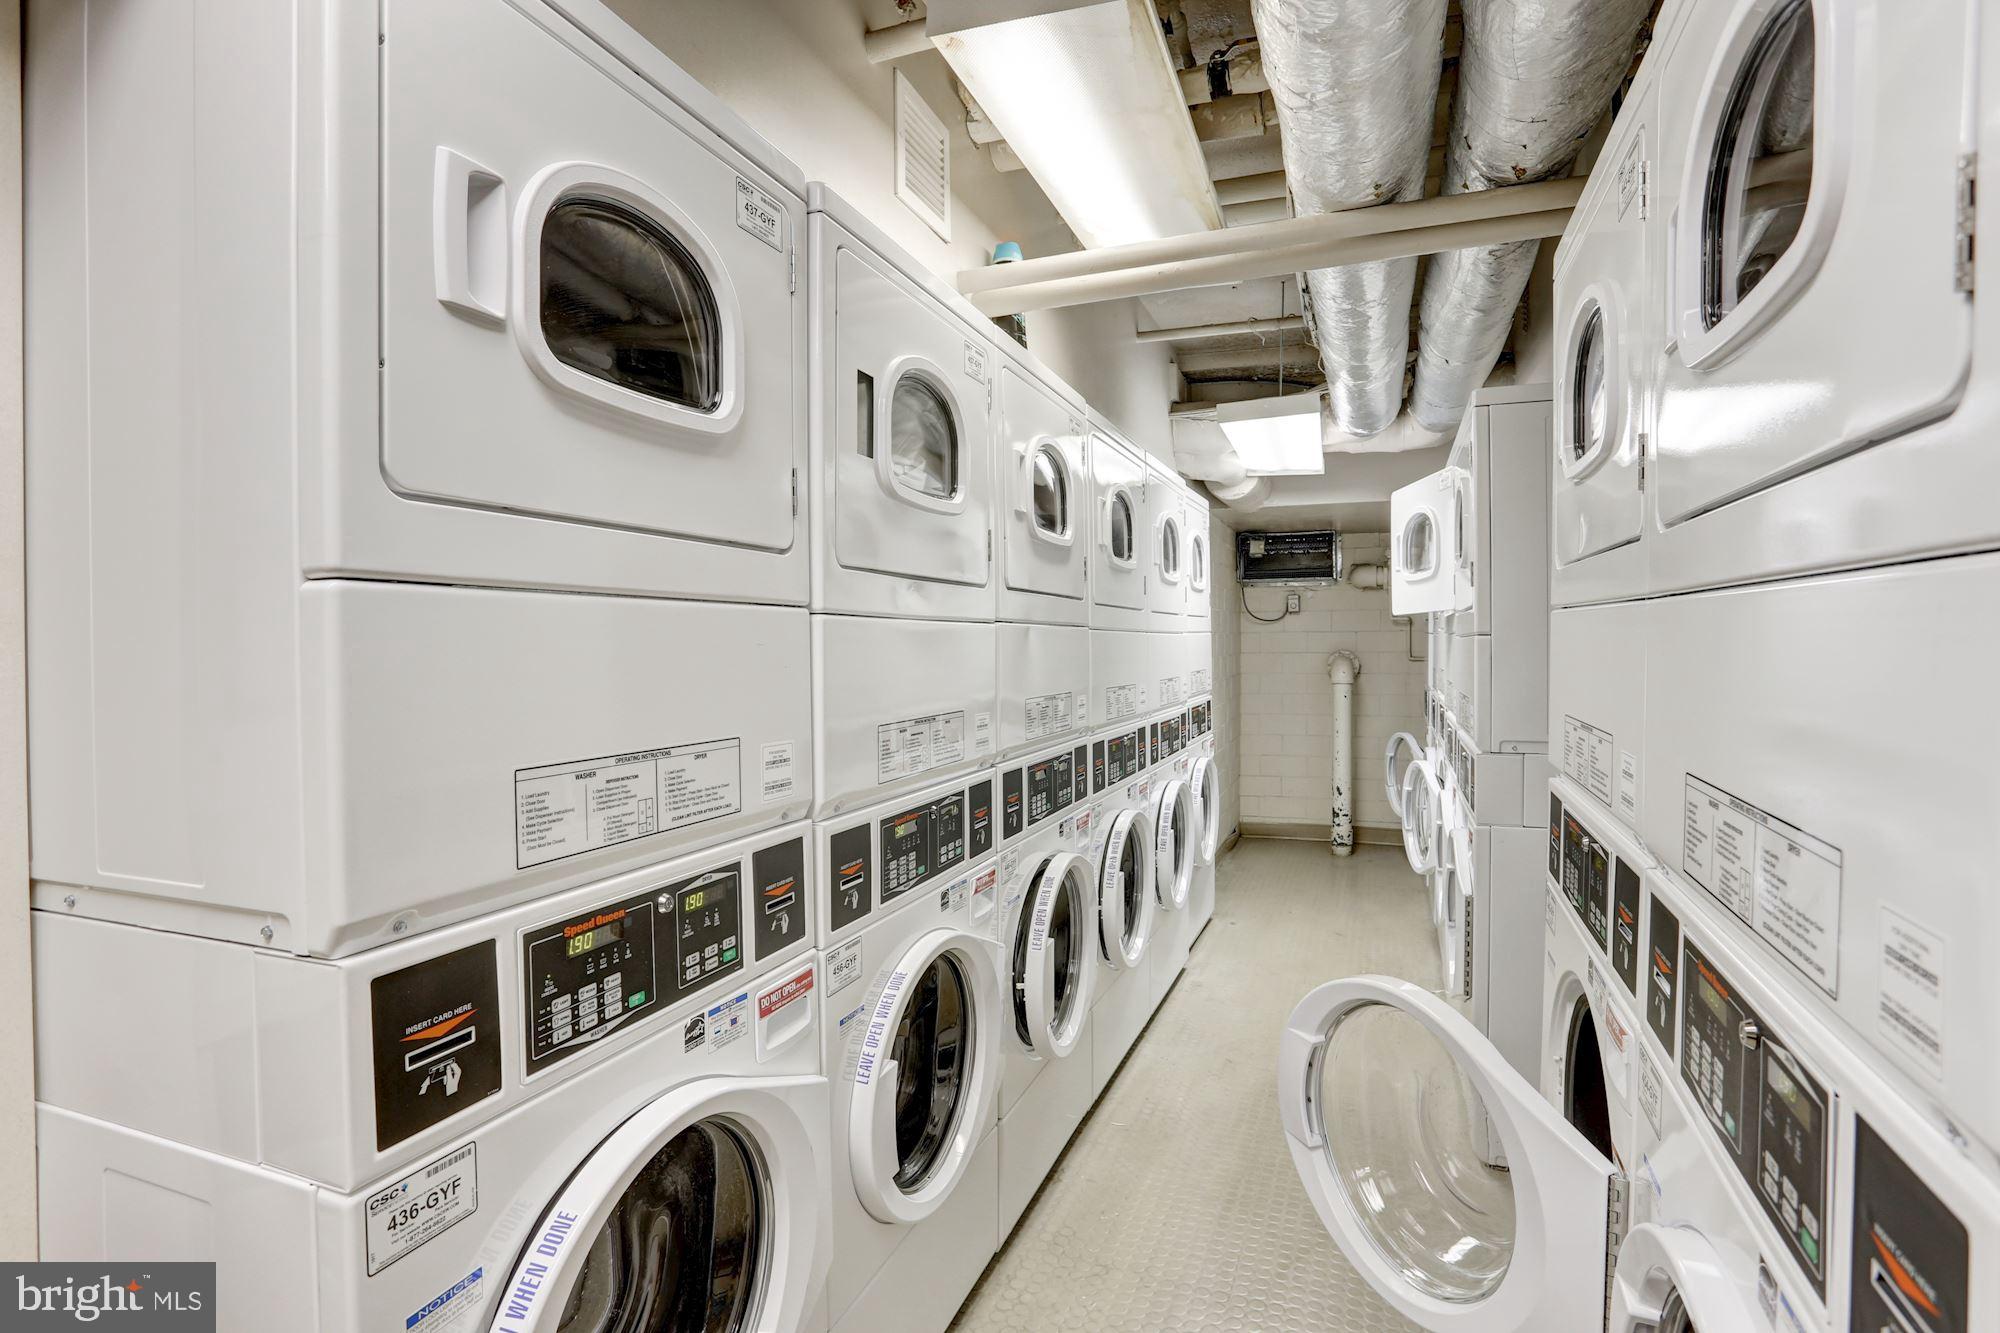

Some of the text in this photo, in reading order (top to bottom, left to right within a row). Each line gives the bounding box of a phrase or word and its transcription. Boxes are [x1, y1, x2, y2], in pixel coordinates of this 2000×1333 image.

[745, 202, 775, 228] 437-GYF
[614, 750, 671, 764] OPERATING INSTRUCTIONS
[574, 771, 596, 780] WASHER
[1106, 872, 1115, 889] LEAVE
[1038, 889, 1051, 906] WHEN
[563, 908, 626, 938] Speed Queen
[1035, 909, 1047, 927] OPEN
[1031, 928, 1044, 951] LEAVE
[832, 954, 857, 975] 456-GYF
[760, 996, 770, 1009] DO
[770, 989, 782, 1004] NOT
[405, 1002, 472, 1036] INSERT CARD HERE
[856, 970, 908, 1085] LEAVE OPEN WHEN DONE
[590, 1025, 608, 1038] WASHER
[369, 1188, 400, 1211] CSC
[386, 1176, 462, 1232] 436-GYF
[504, 1262, 549, 1321] WHEN
[535, 1210, 579, 1258] DONE
[417, 1274, 475, 1320] NOTICE
